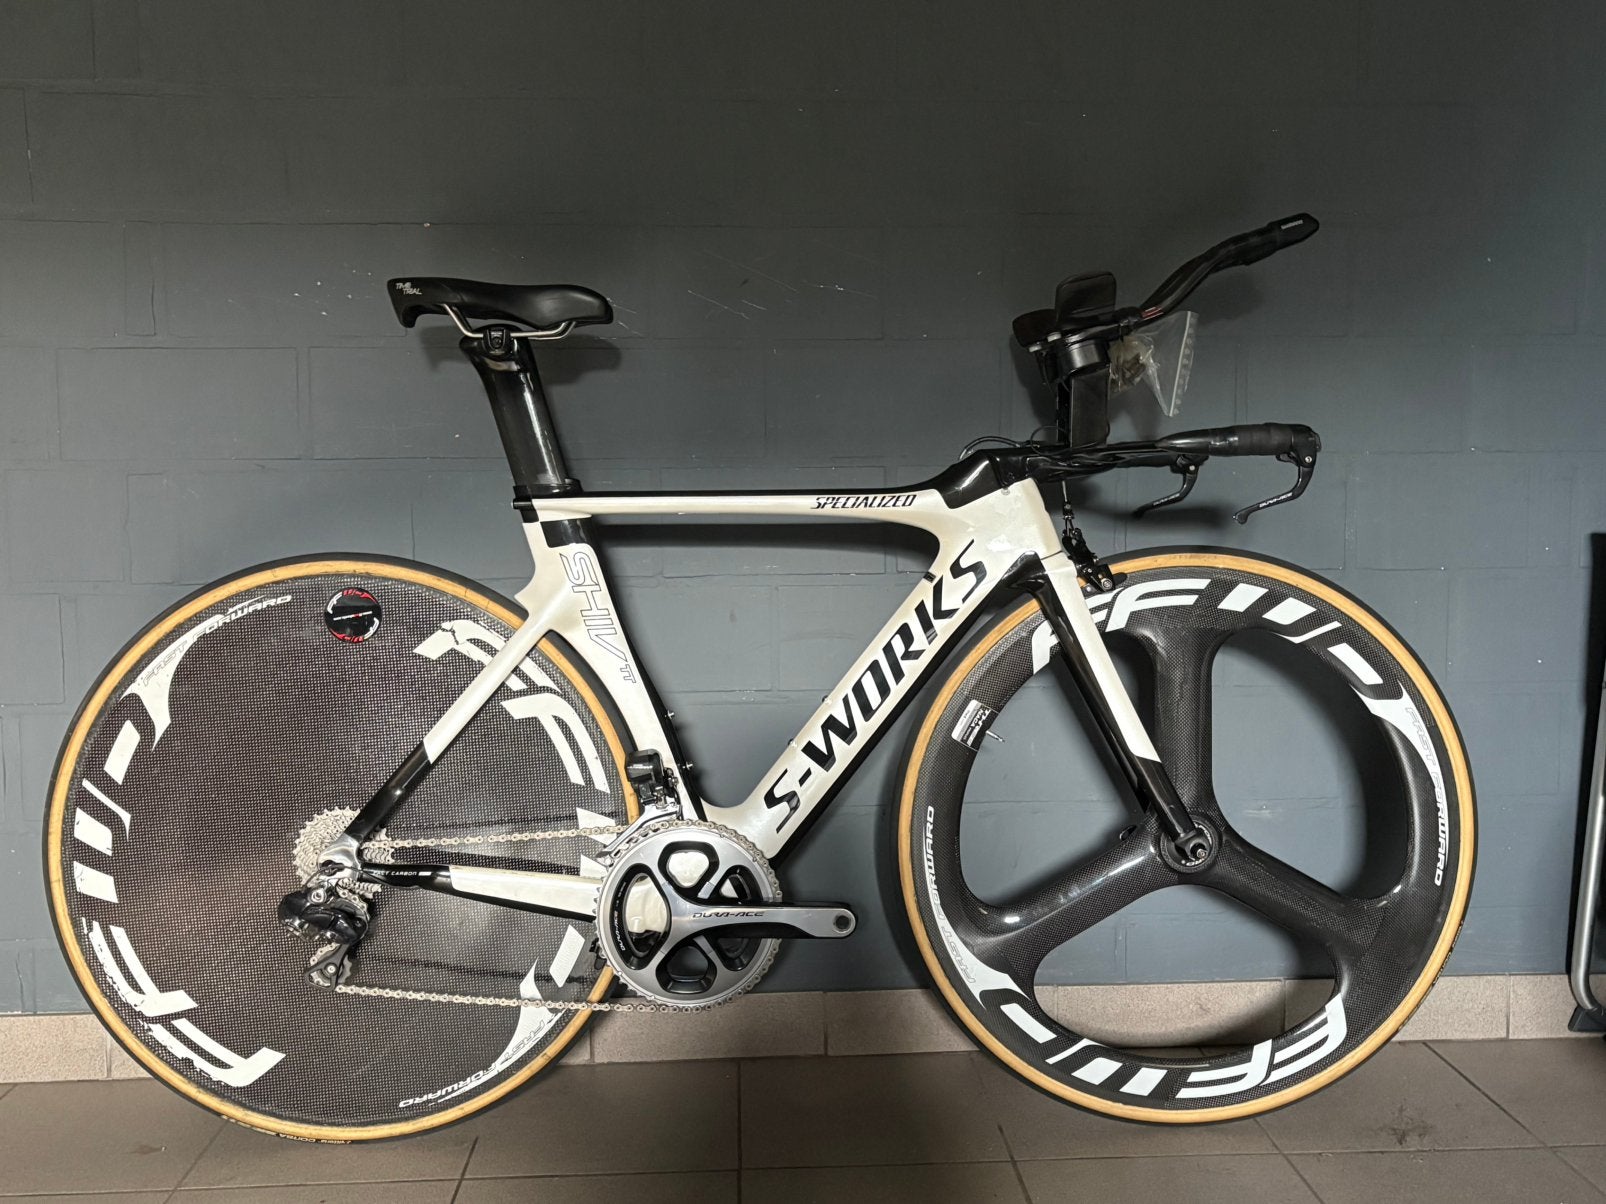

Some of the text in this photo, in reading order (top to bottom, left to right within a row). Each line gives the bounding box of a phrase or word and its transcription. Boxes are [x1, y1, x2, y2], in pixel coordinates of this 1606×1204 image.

[810, 494, 917, 509] SPECIALIZED
[143, 595, 292, 686] FAST FORWARD
[559, 551, 628, 662] SHIV
[763, 538, 988, 835] S-WORKS
[1405, 707, 1448, 887] FAST FORWARD
[926, 805, 976, 984] FAST FORWARD
[398, 1019, 546, 1108] FAST FORWARD
